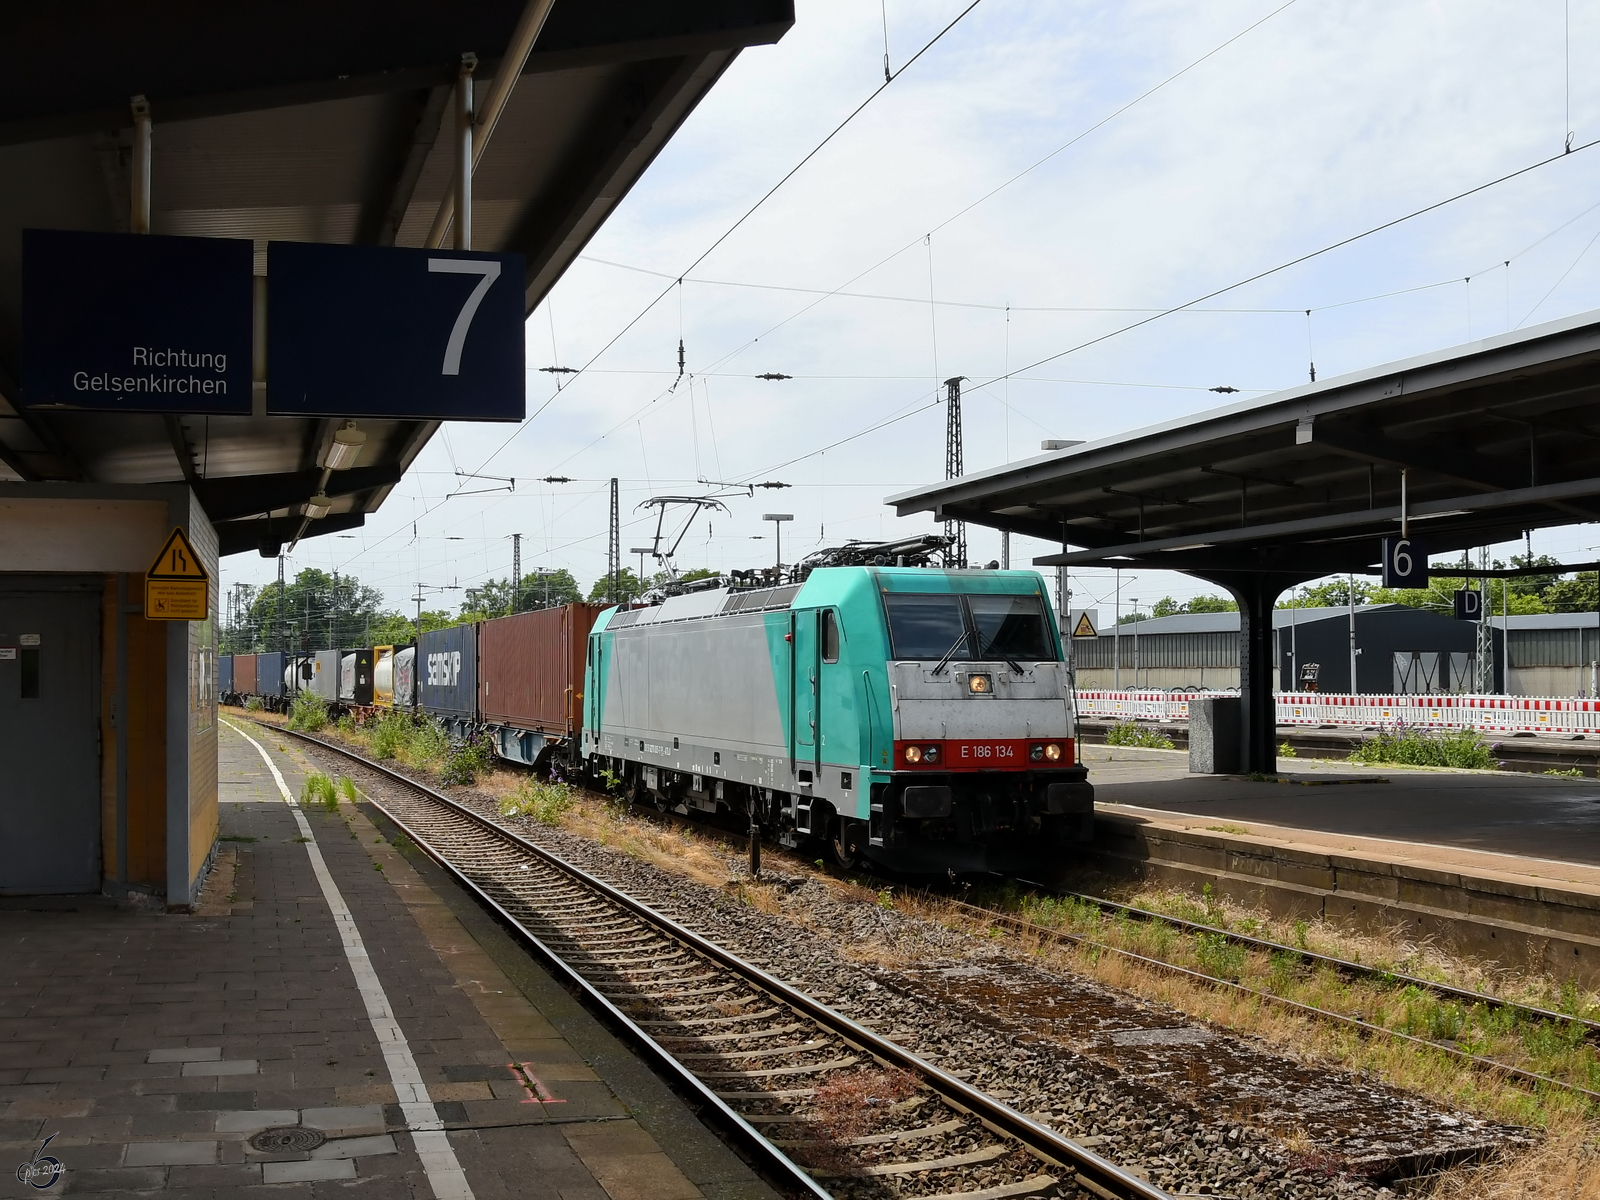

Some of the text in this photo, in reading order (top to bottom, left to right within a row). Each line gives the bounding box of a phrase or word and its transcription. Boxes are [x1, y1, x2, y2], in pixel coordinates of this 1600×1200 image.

[428, 258, 502, 376] 7
[133, 346, 227, 373] Richtung
[73, 371, 227, 394] Gelsenkirchen
[1393, 540, 1413, 577] 6
[1465, 591, 1479, 614] D
[961, 745, 1014, 758] E 186 134
